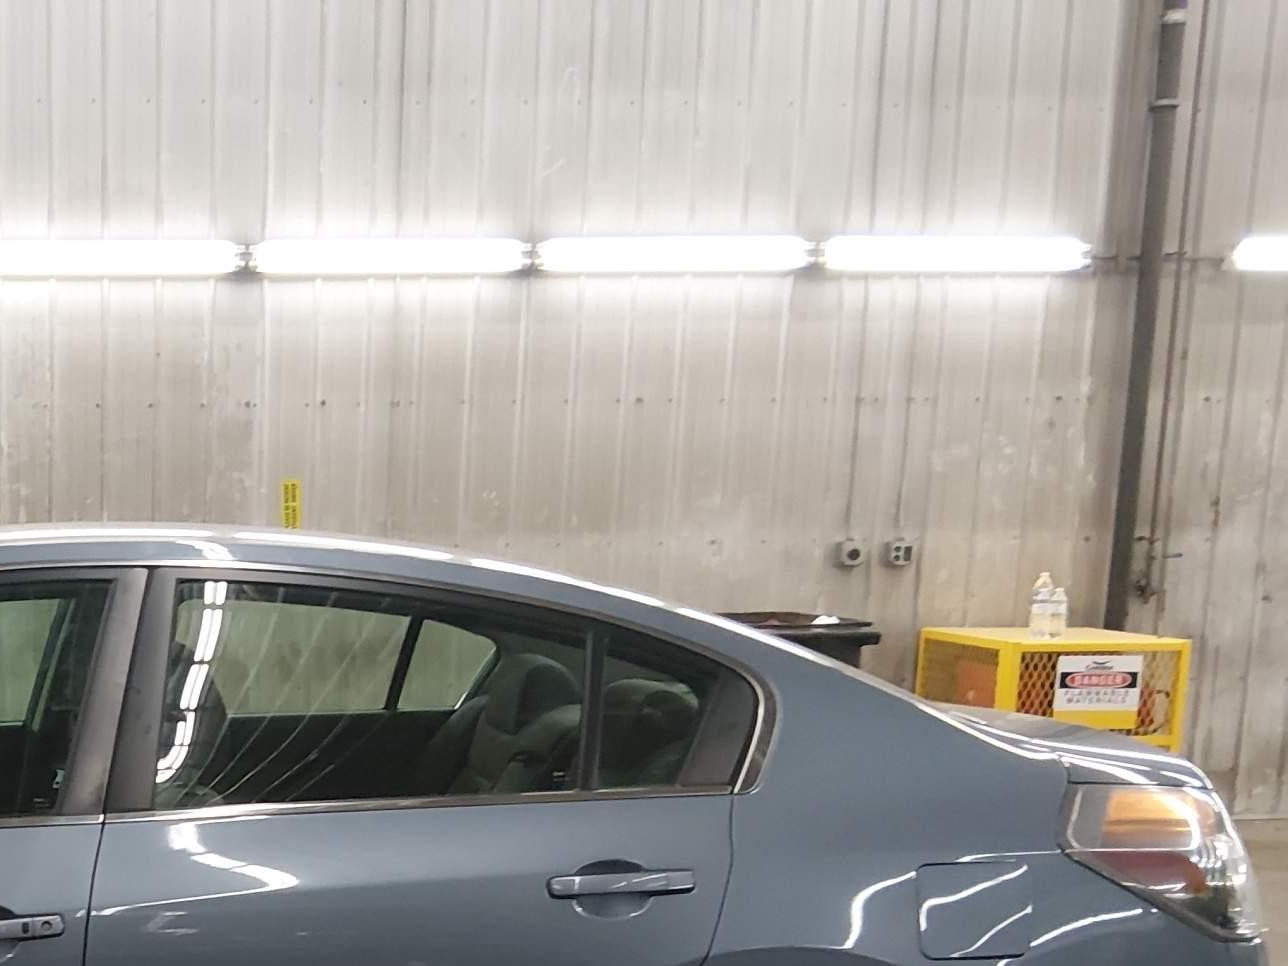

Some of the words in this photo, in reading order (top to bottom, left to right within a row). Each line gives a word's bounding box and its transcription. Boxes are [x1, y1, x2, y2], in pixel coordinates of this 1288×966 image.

[1074, 675, 1123, 685] DANGER
[1064, 689, 1129, 697] FLAMMABLE
[1066, 696, 1127, 705] MATERIALS
